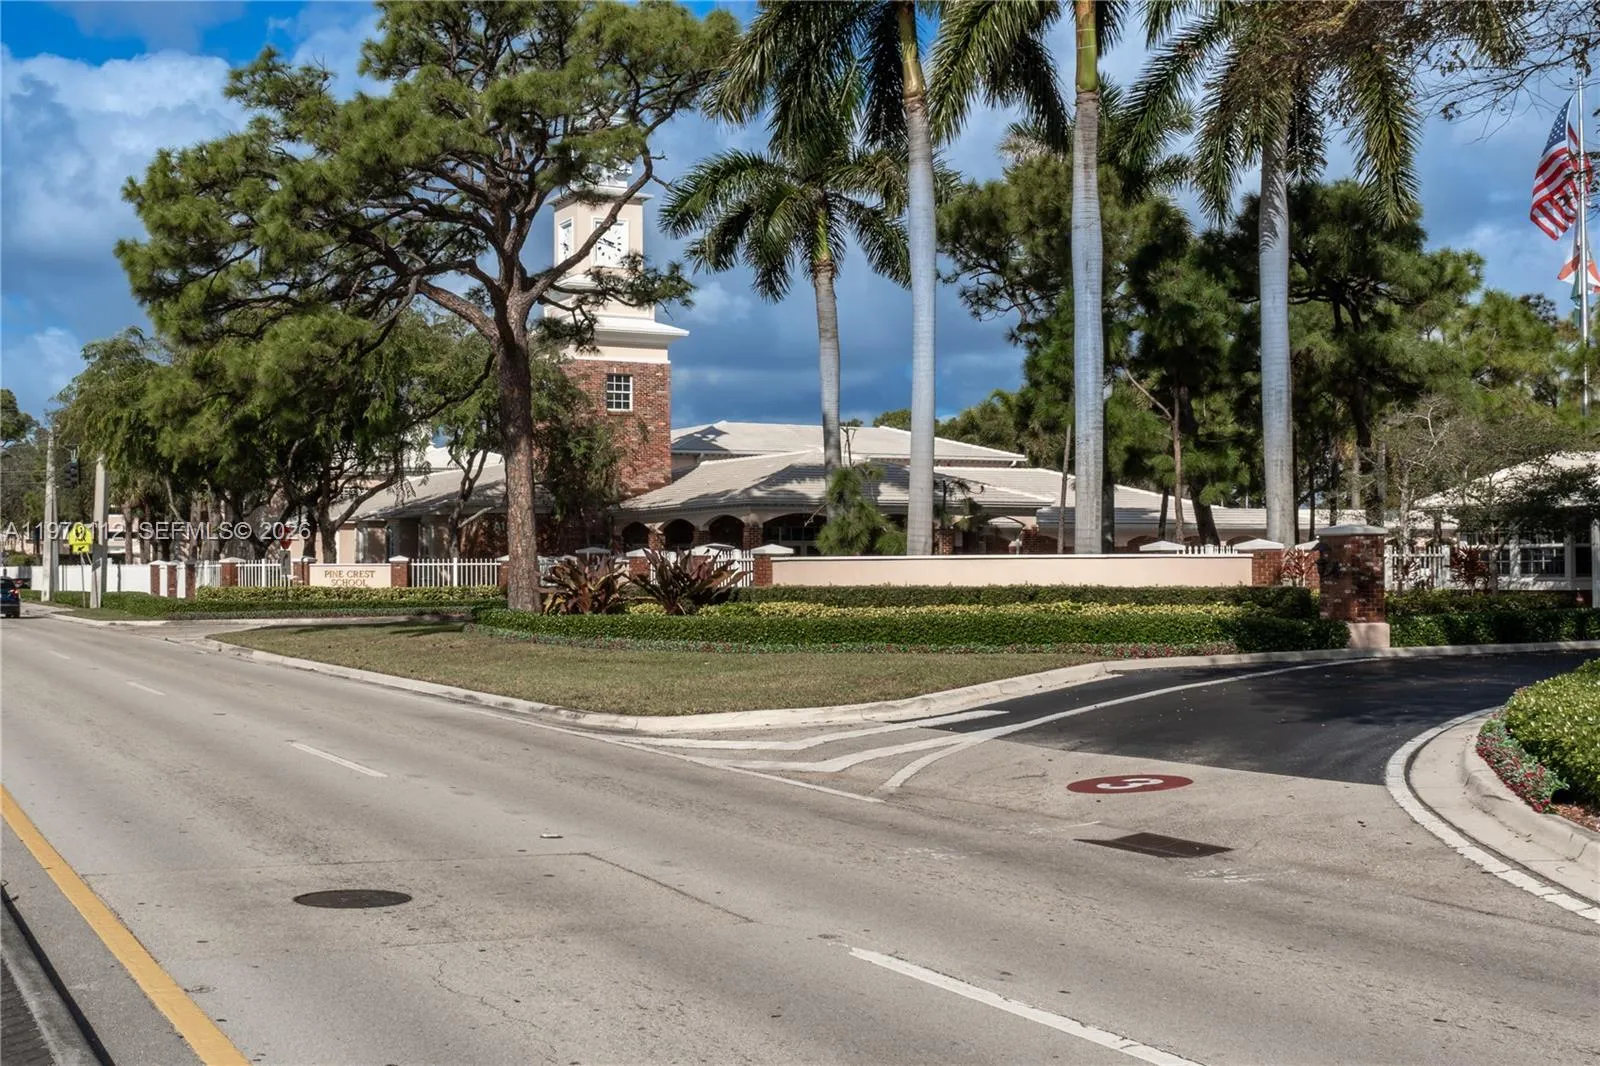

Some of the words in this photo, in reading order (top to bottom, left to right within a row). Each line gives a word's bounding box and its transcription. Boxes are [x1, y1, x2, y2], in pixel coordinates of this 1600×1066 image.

[324, 570, 344, 578] PINE
[346, 570, 376, 578] CREST
[331, 578, 368, 587] SCHOOL
